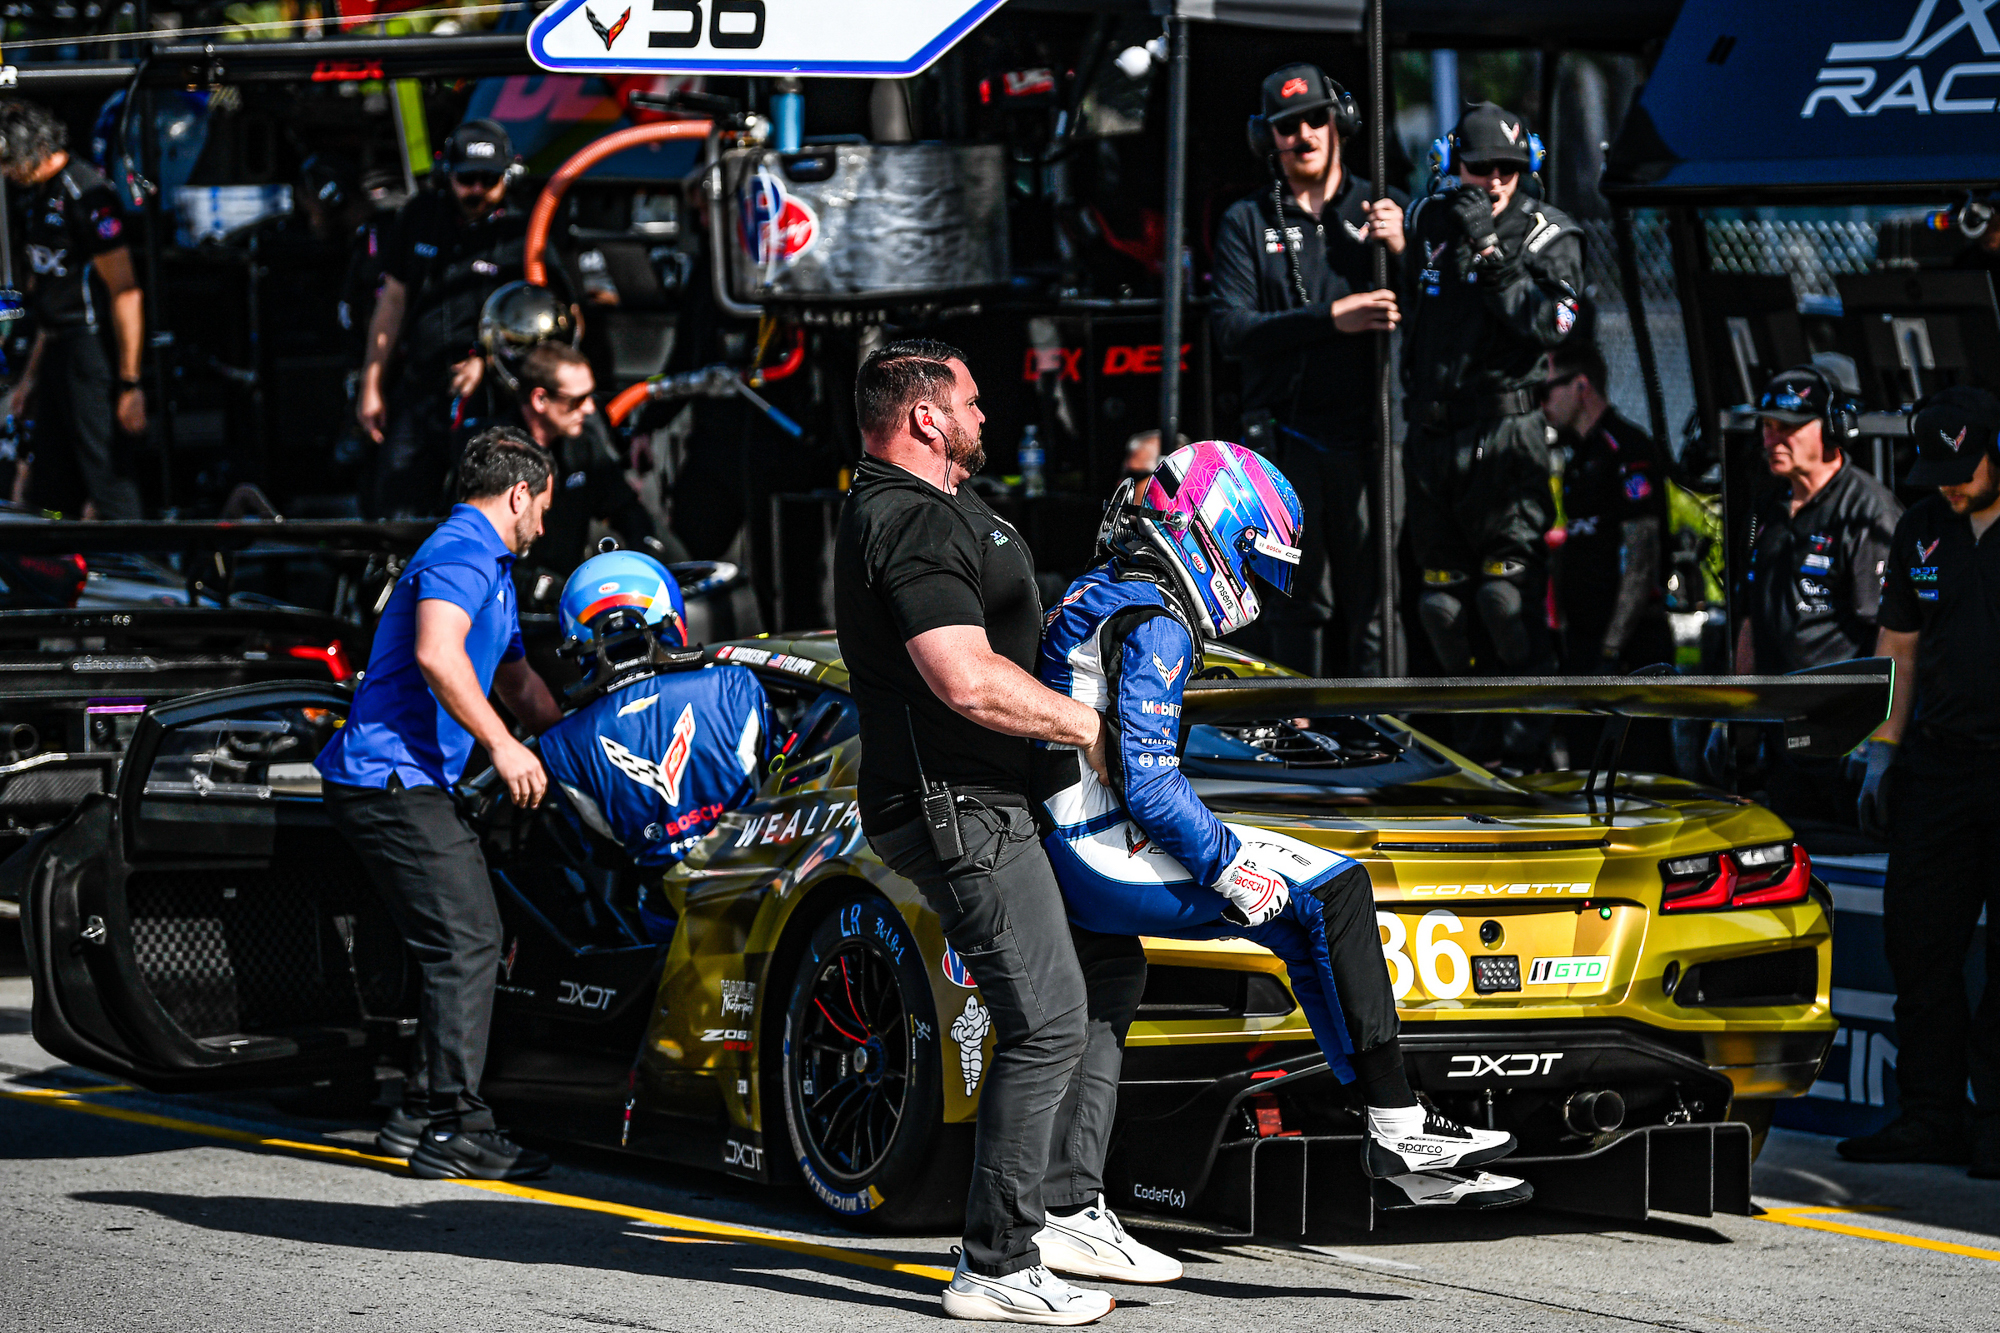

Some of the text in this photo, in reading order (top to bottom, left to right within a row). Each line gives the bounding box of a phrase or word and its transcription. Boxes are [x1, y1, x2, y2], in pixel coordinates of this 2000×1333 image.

[1800, 61, 2000, 118] RAC
[1214, 580, 1235, 610] onsemi
[665, 802, 724, 837] BOSCH
[1236, 876, 1264, 894] BOSCH
[1411, 883, 1592, 896] CORVETTE
[840, 903, 861, 938] LR
[1554, 962, 1602, 978] GTD
[1397, 1142, 1443, 1155] sparco
[803, 1163, 857, 1211] MICHELIN
[1134, 1183, 1186, 1209] CodeF(x)
